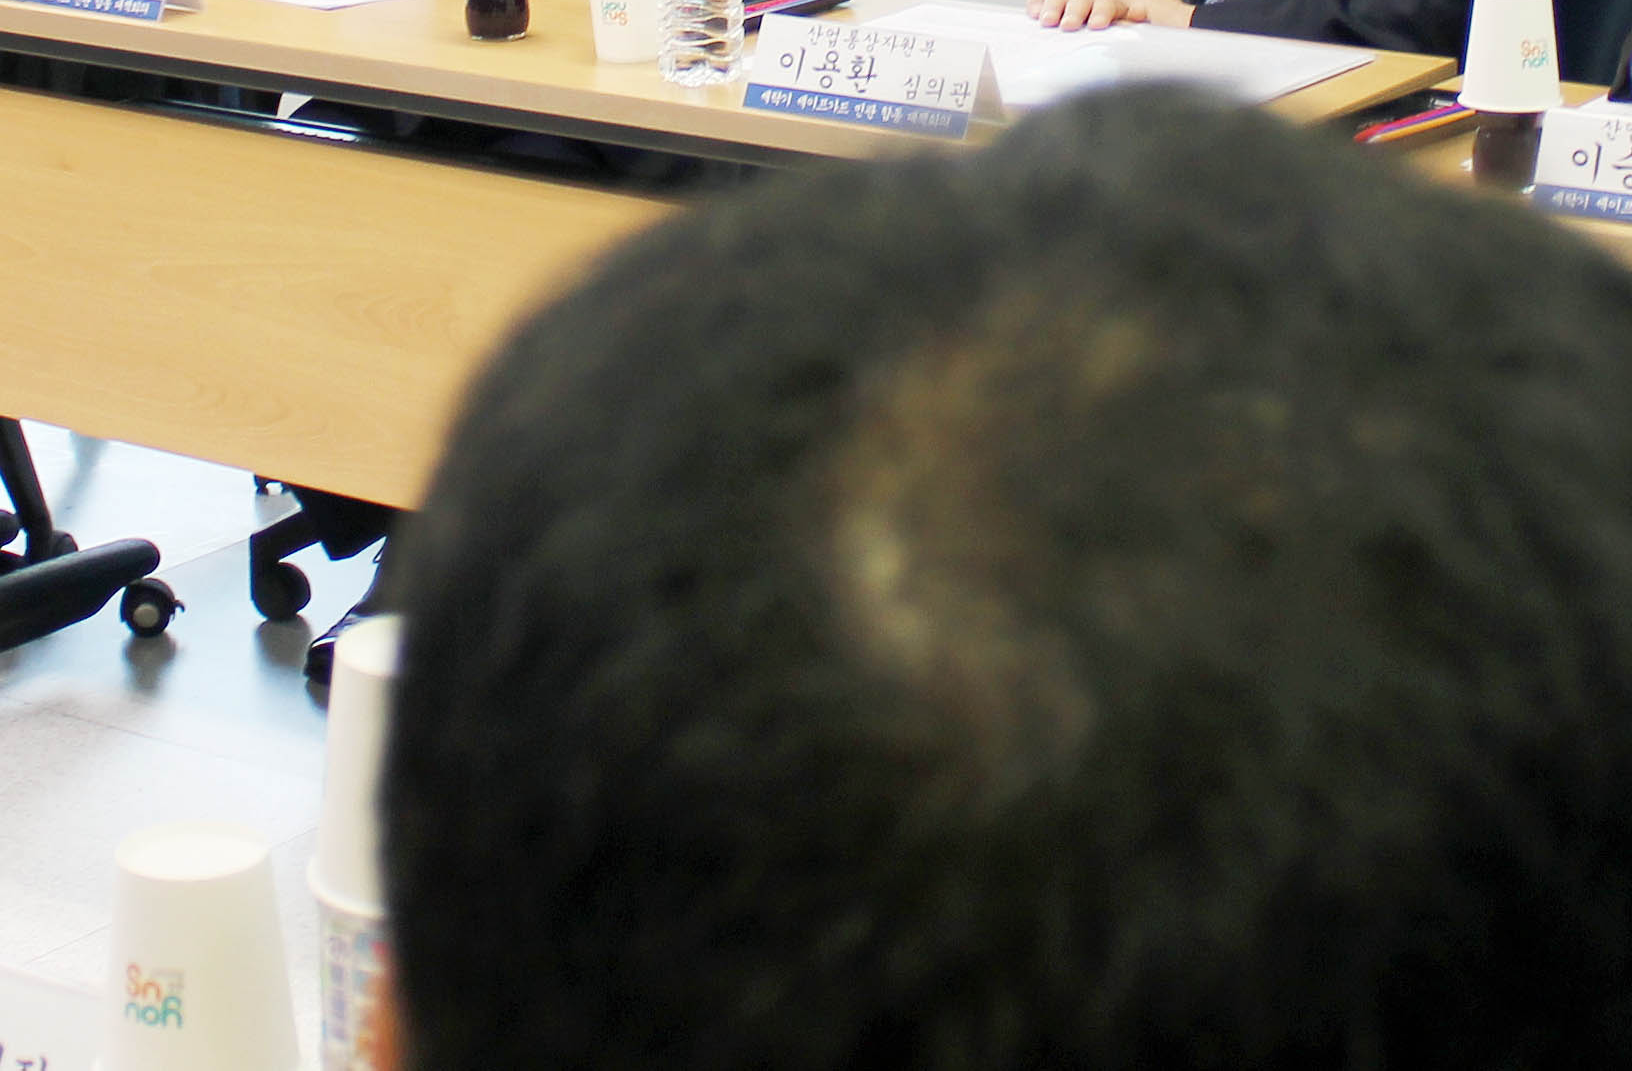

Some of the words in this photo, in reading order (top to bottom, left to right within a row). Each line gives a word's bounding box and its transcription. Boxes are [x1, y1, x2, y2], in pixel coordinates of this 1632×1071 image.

[807, 23, 937, 60] 산업통상자원부
[779, 45, 879, 94] 이용환
[902, 74, 971, 109] 심의관
[125, 996, 184, 1029] you
